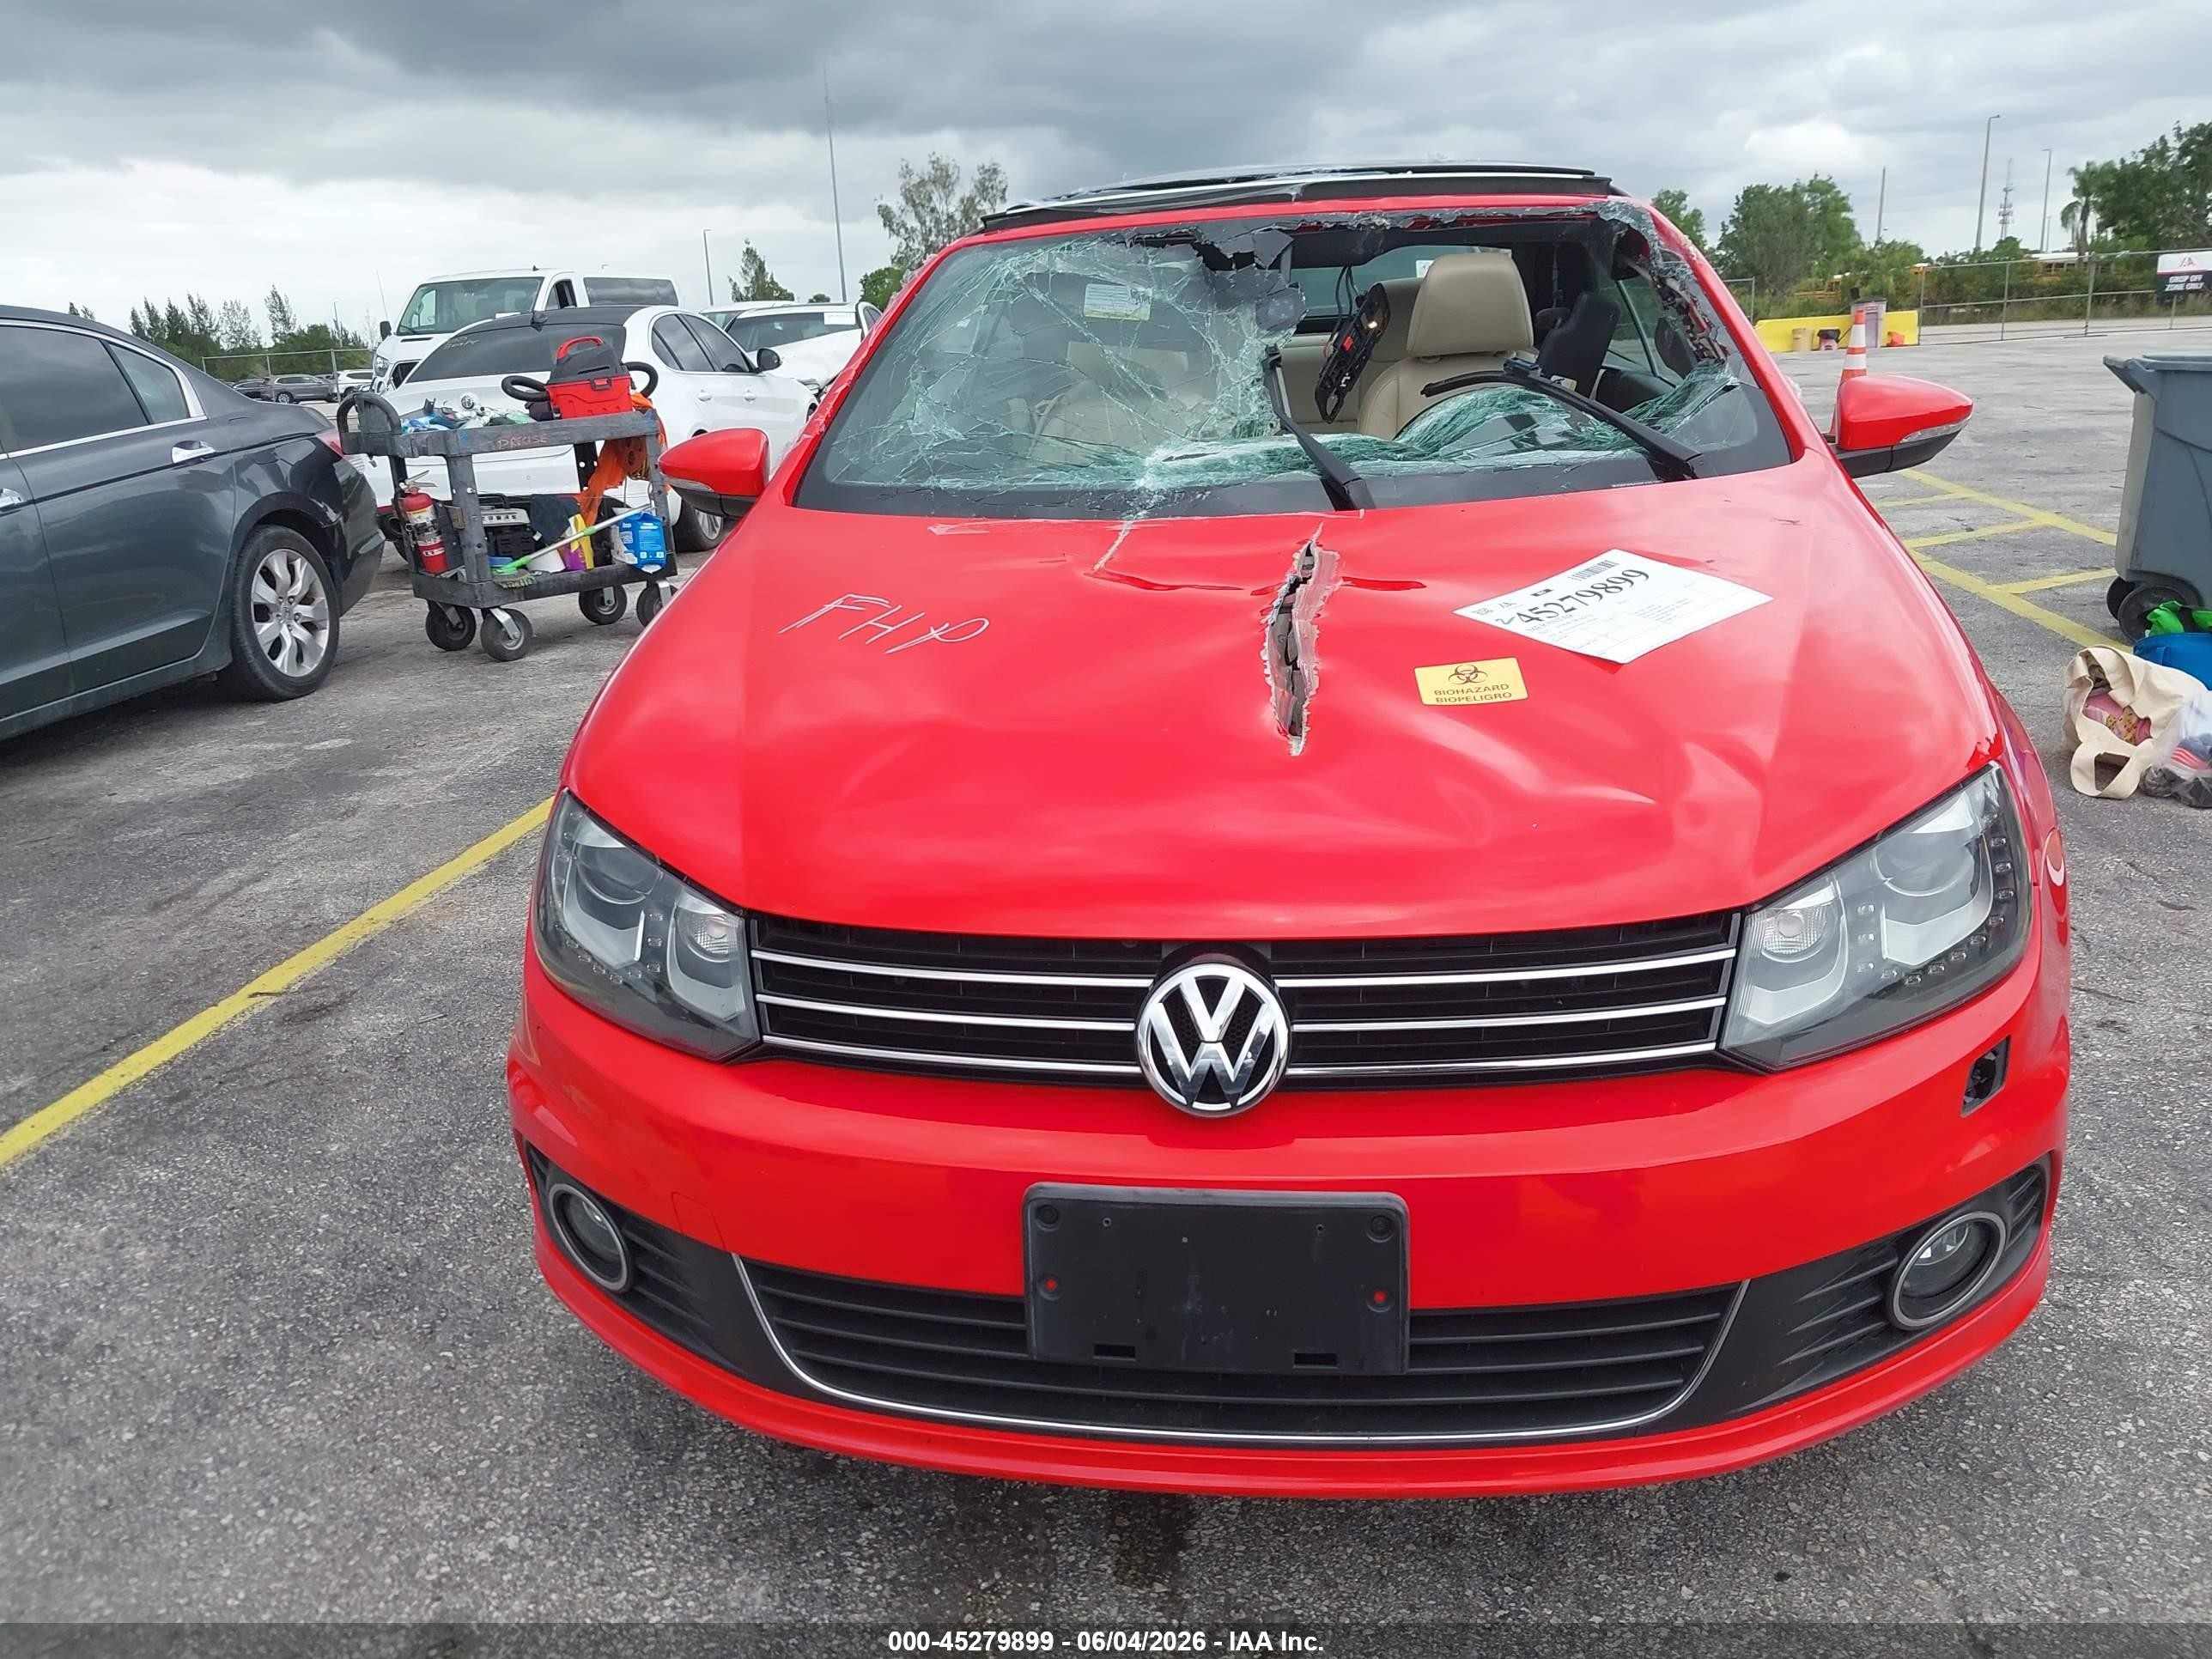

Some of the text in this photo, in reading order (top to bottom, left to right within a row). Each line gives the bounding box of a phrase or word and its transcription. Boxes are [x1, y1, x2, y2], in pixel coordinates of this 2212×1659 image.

[1516, 568, 1650, 624] 45279899
[1434, 684, 1510, 696] BIOHAZARD
[1436, 692, 1512, 703] BIOPELIGRO
[1137, 955, 1291, 1118] VW
